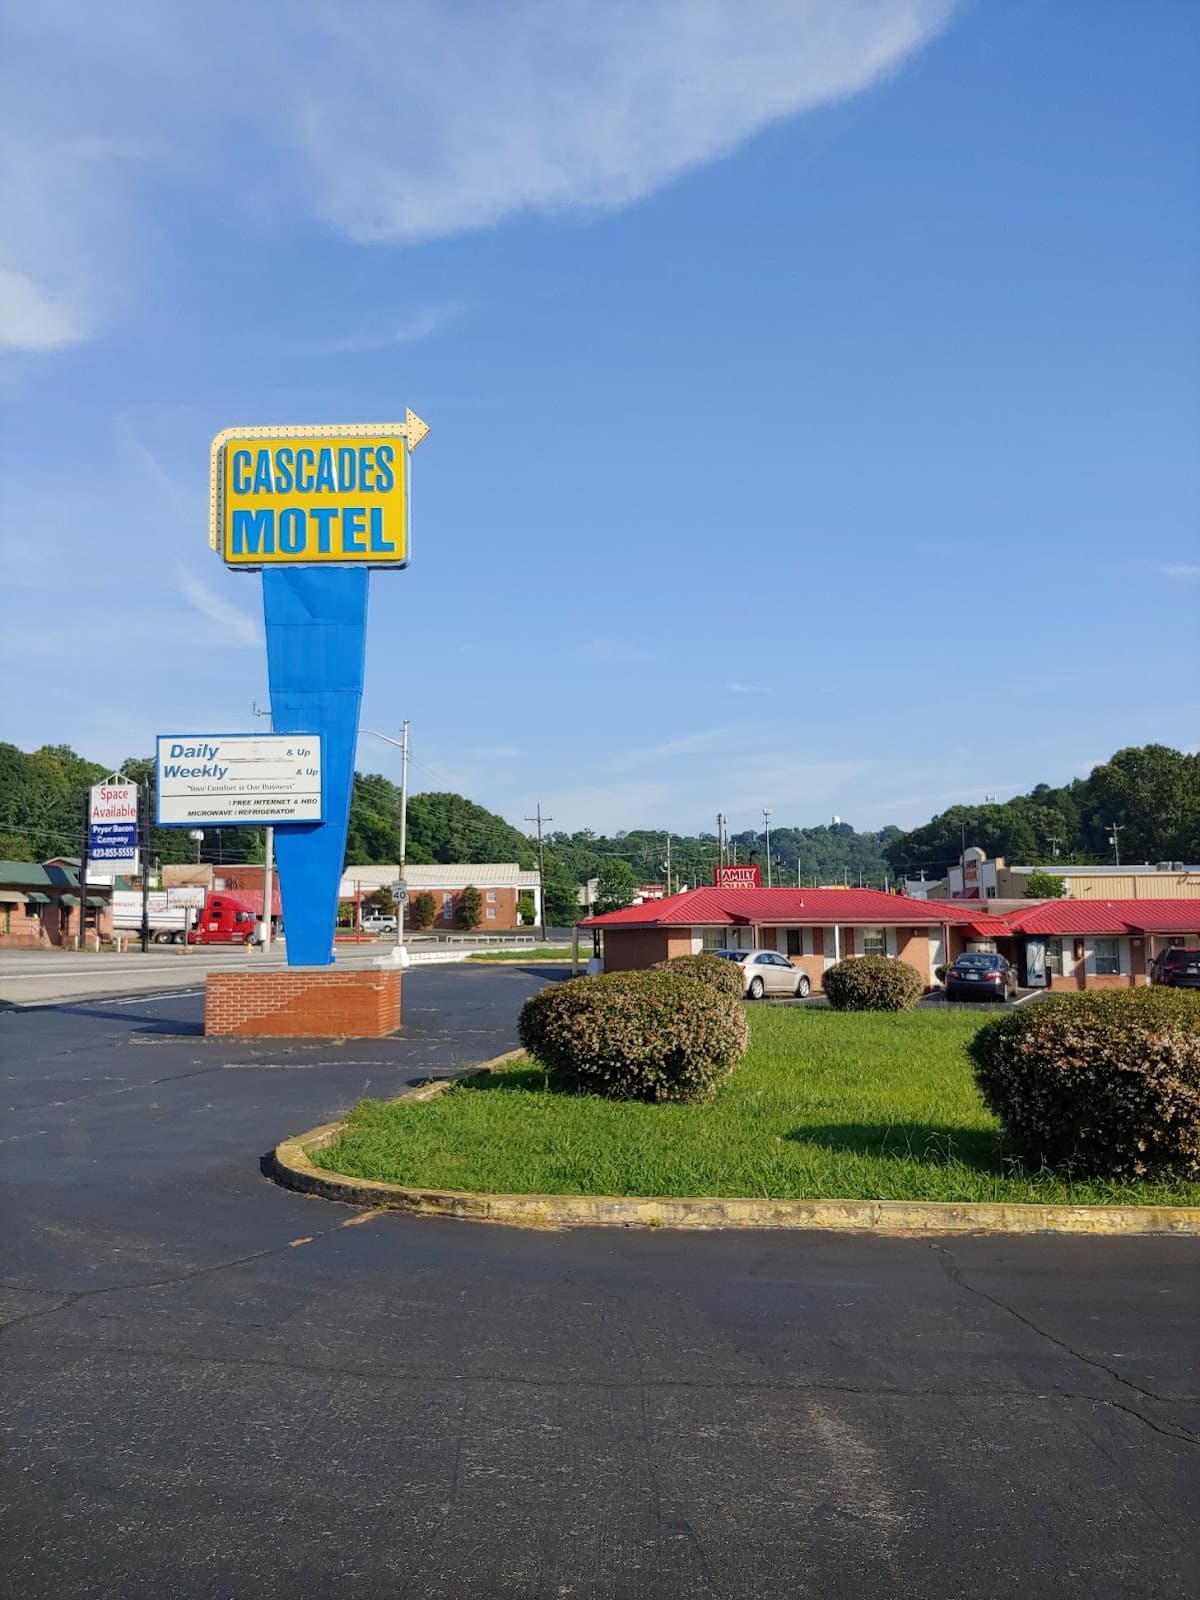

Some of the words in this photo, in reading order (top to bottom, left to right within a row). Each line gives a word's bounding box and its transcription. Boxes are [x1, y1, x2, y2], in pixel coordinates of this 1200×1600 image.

[232, 445, 396, 495] CASCADES
[232, 507, 396, 555] MOTEL
[170, 744, 220, 760] Daily
[297, 749, 311, 757] Up
[164, 764, 228, 780] Weekly
[306, 768, 319, 776] Up
[100, 787, 129, 802] Space
[92, 803, 136, 818] Available
[92, 825, 112, 835] Pryor
[96, 836, 129, 845] Company
[393, 891, 406, 899] 40
